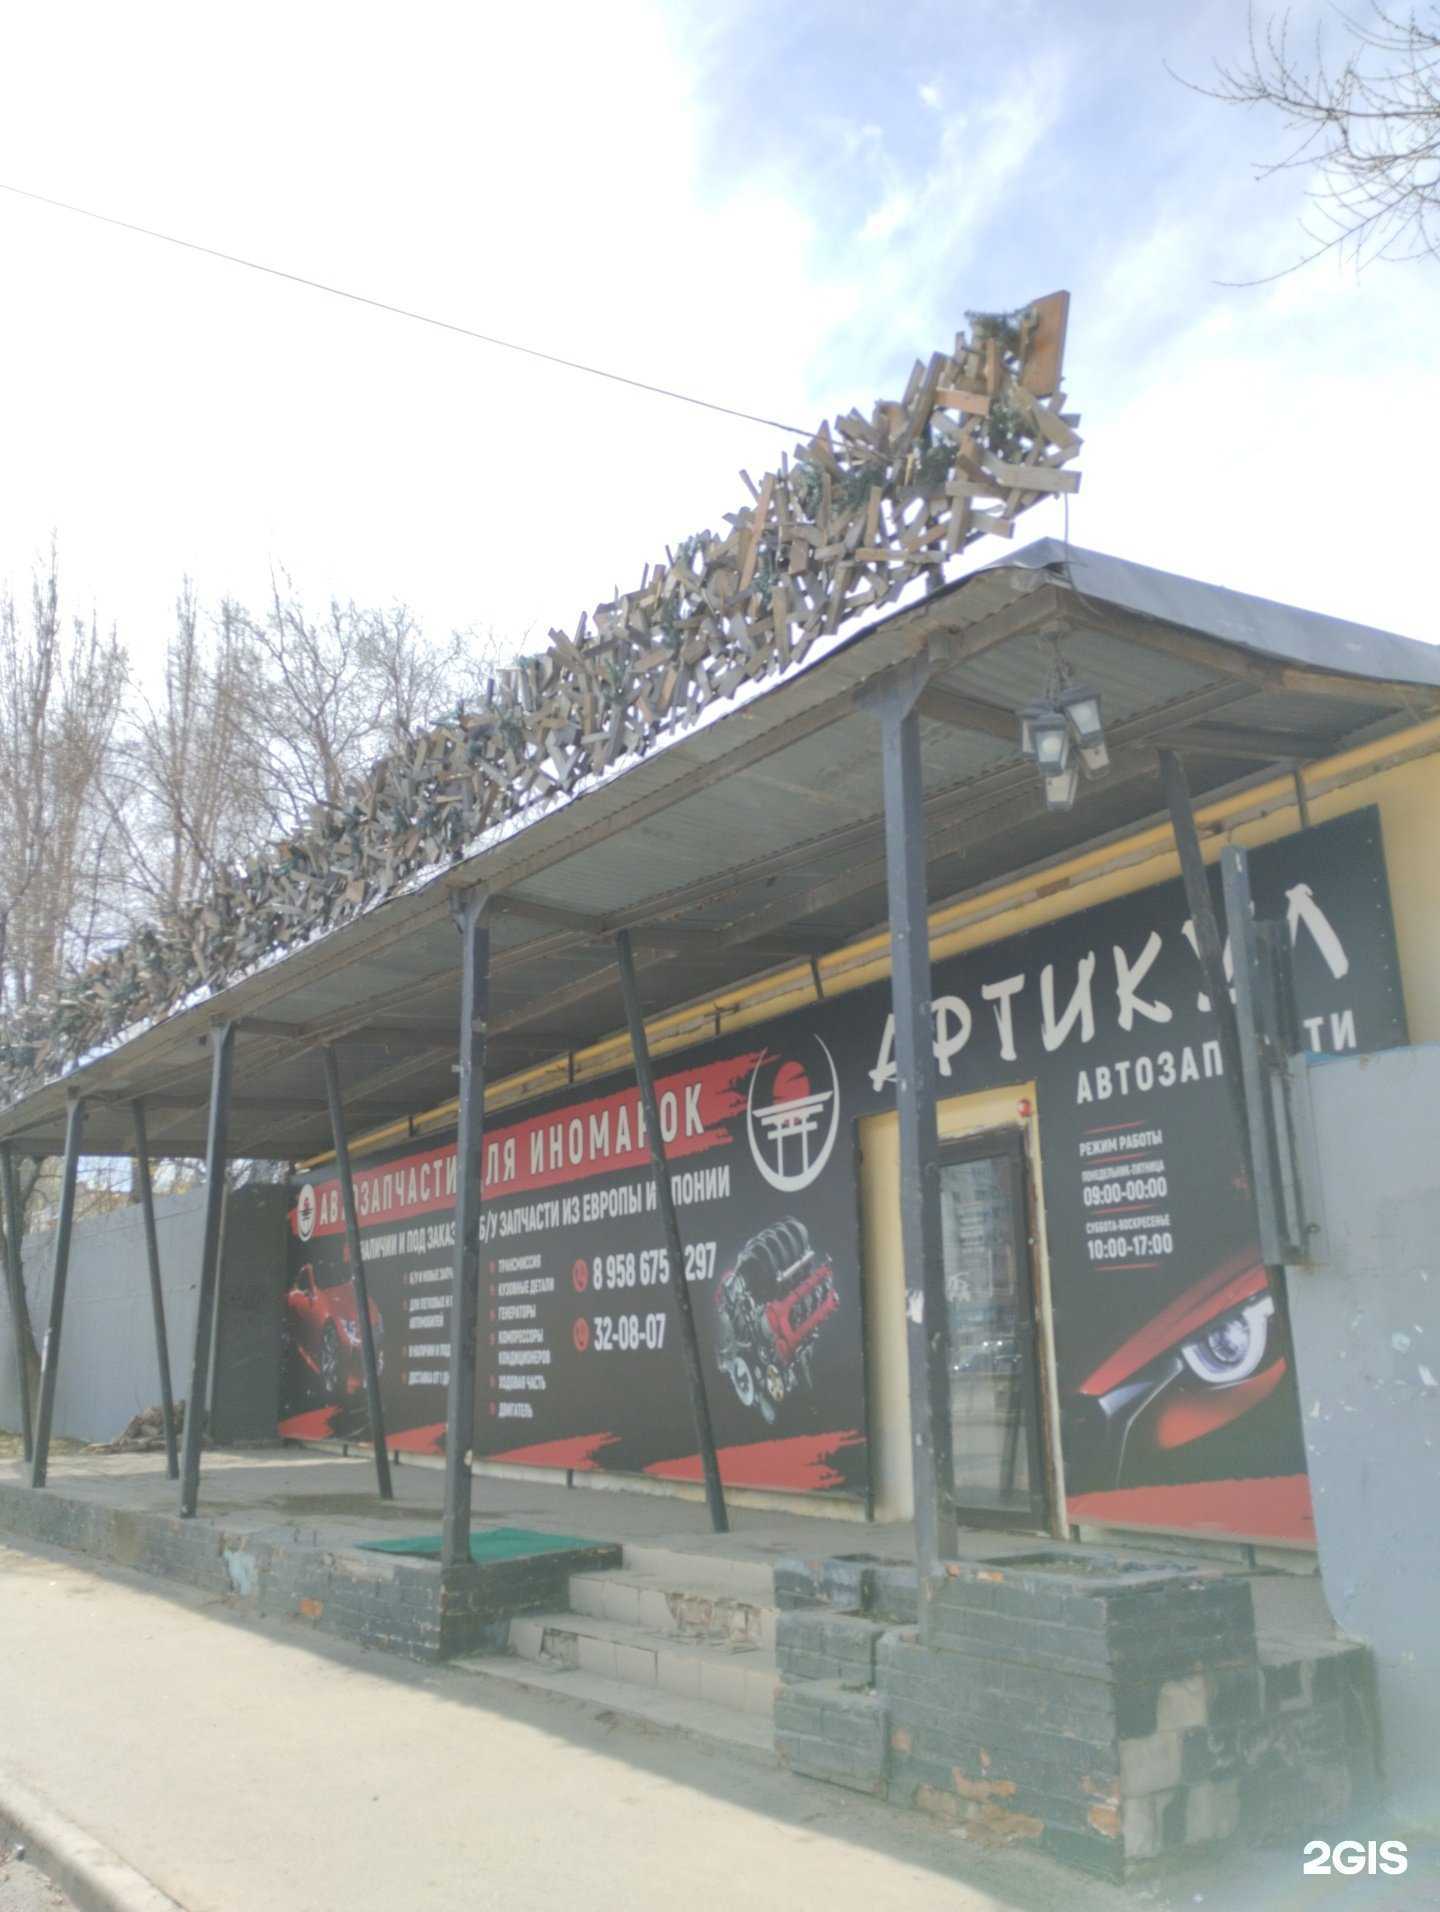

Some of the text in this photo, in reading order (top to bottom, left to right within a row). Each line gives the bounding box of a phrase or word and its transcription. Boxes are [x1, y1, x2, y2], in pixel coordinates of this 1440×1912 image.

[1075, 1009, 1357, 1105] АВТОЗАПТИ
[1079, 1129, 1163, 1157] РЕЖИМ РАБОТЫ
[480, 1136, 516, 1194] ЛЯ
[407, 1225, 427, 1254] ПОД
[500, 1200, 560, 1237] ЗАПЧАСТИ
[562, 1195, 581, 1226] ИЗ
[582, 1183, 642, 1222] ЕВРОПЫ
[645, 1180, 657, 1212] И
[670, 1164, 731, 1207] ПОНИИ
[1087, 1232, 1174, 1260] 10:00-17:00
[593, 1256, 603, 1290] 8
[605, 1252, 636, 1289] 958
[639, 1248, 670, 1285] 675
[593, 1312, 666, 1351] 32-08-07
